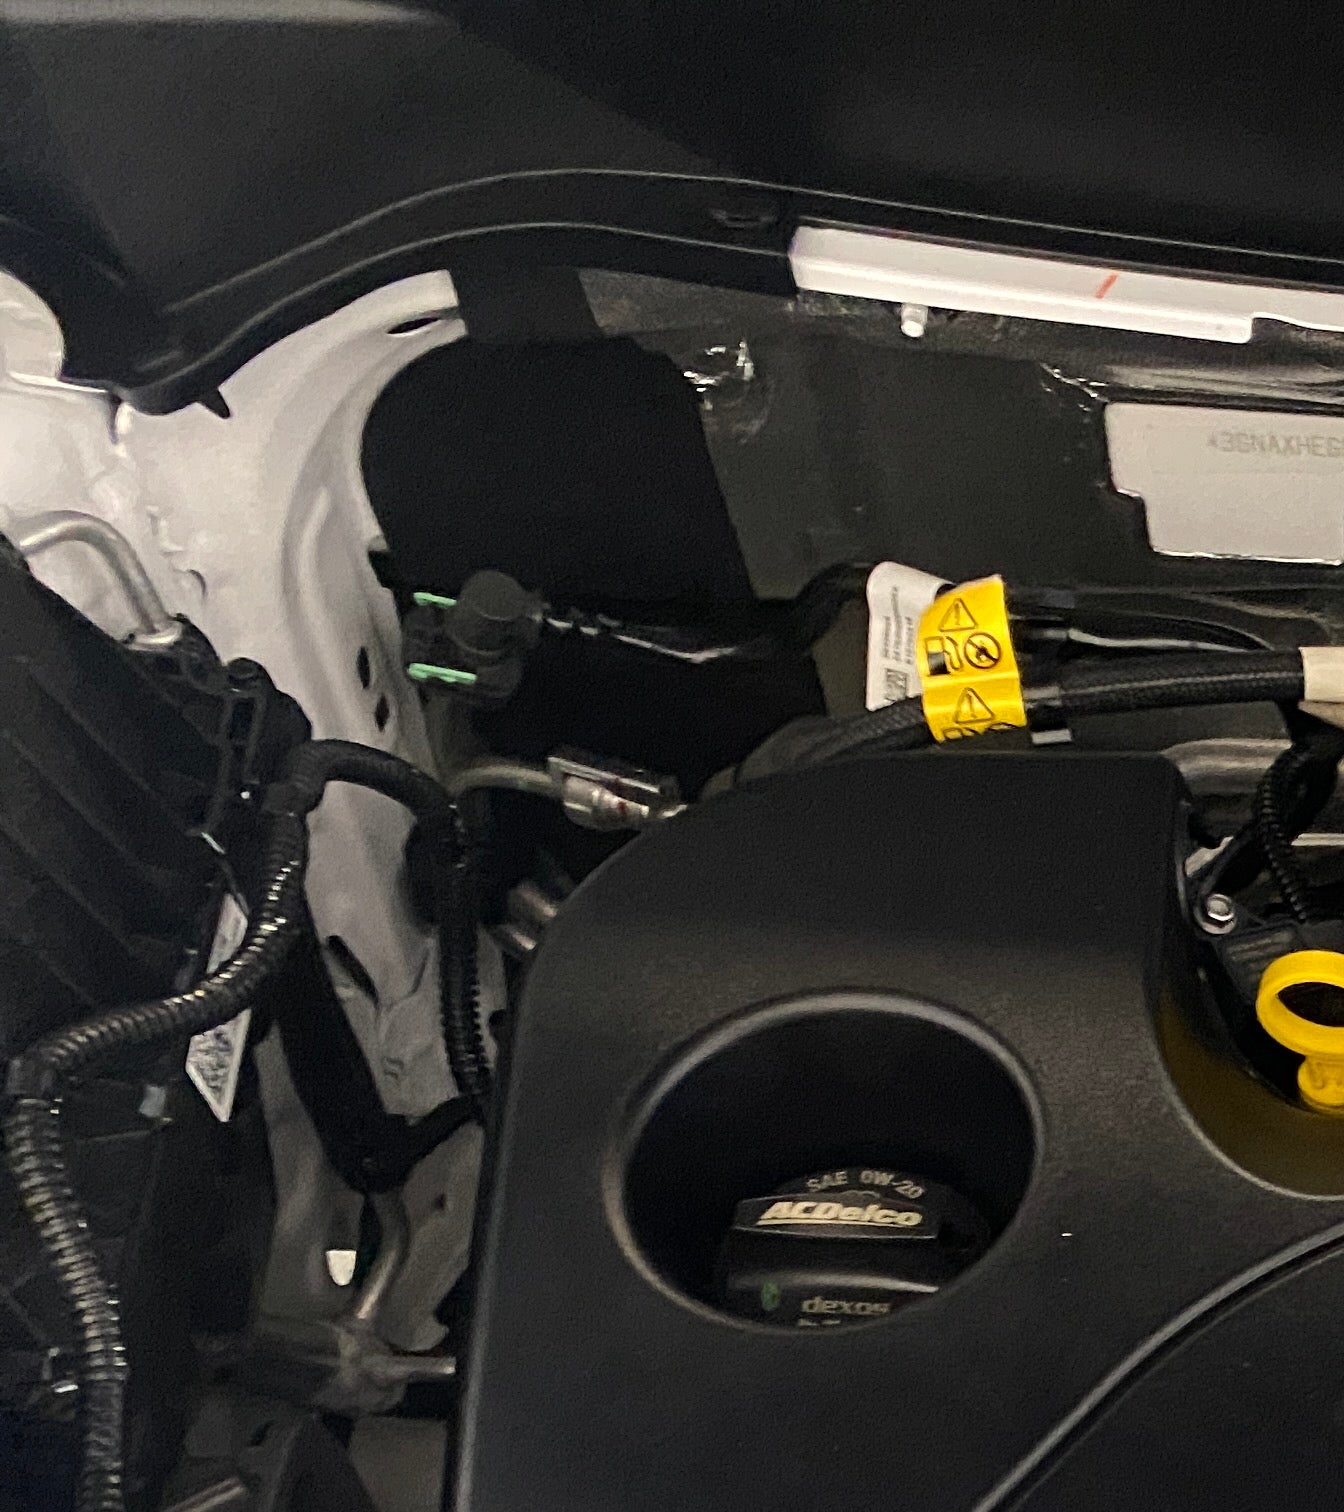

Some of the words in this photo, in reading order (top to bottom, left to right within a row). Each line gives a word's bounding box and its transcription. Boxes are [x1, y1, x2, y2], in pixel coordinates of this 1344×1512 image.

[806, 1170, 848, 1192] SAE
[859, 1169, 926, 1200] 0W-20
[758, 1201, 923, 1227] ACDelco
[801, 1296, 892, 1316] dexos
